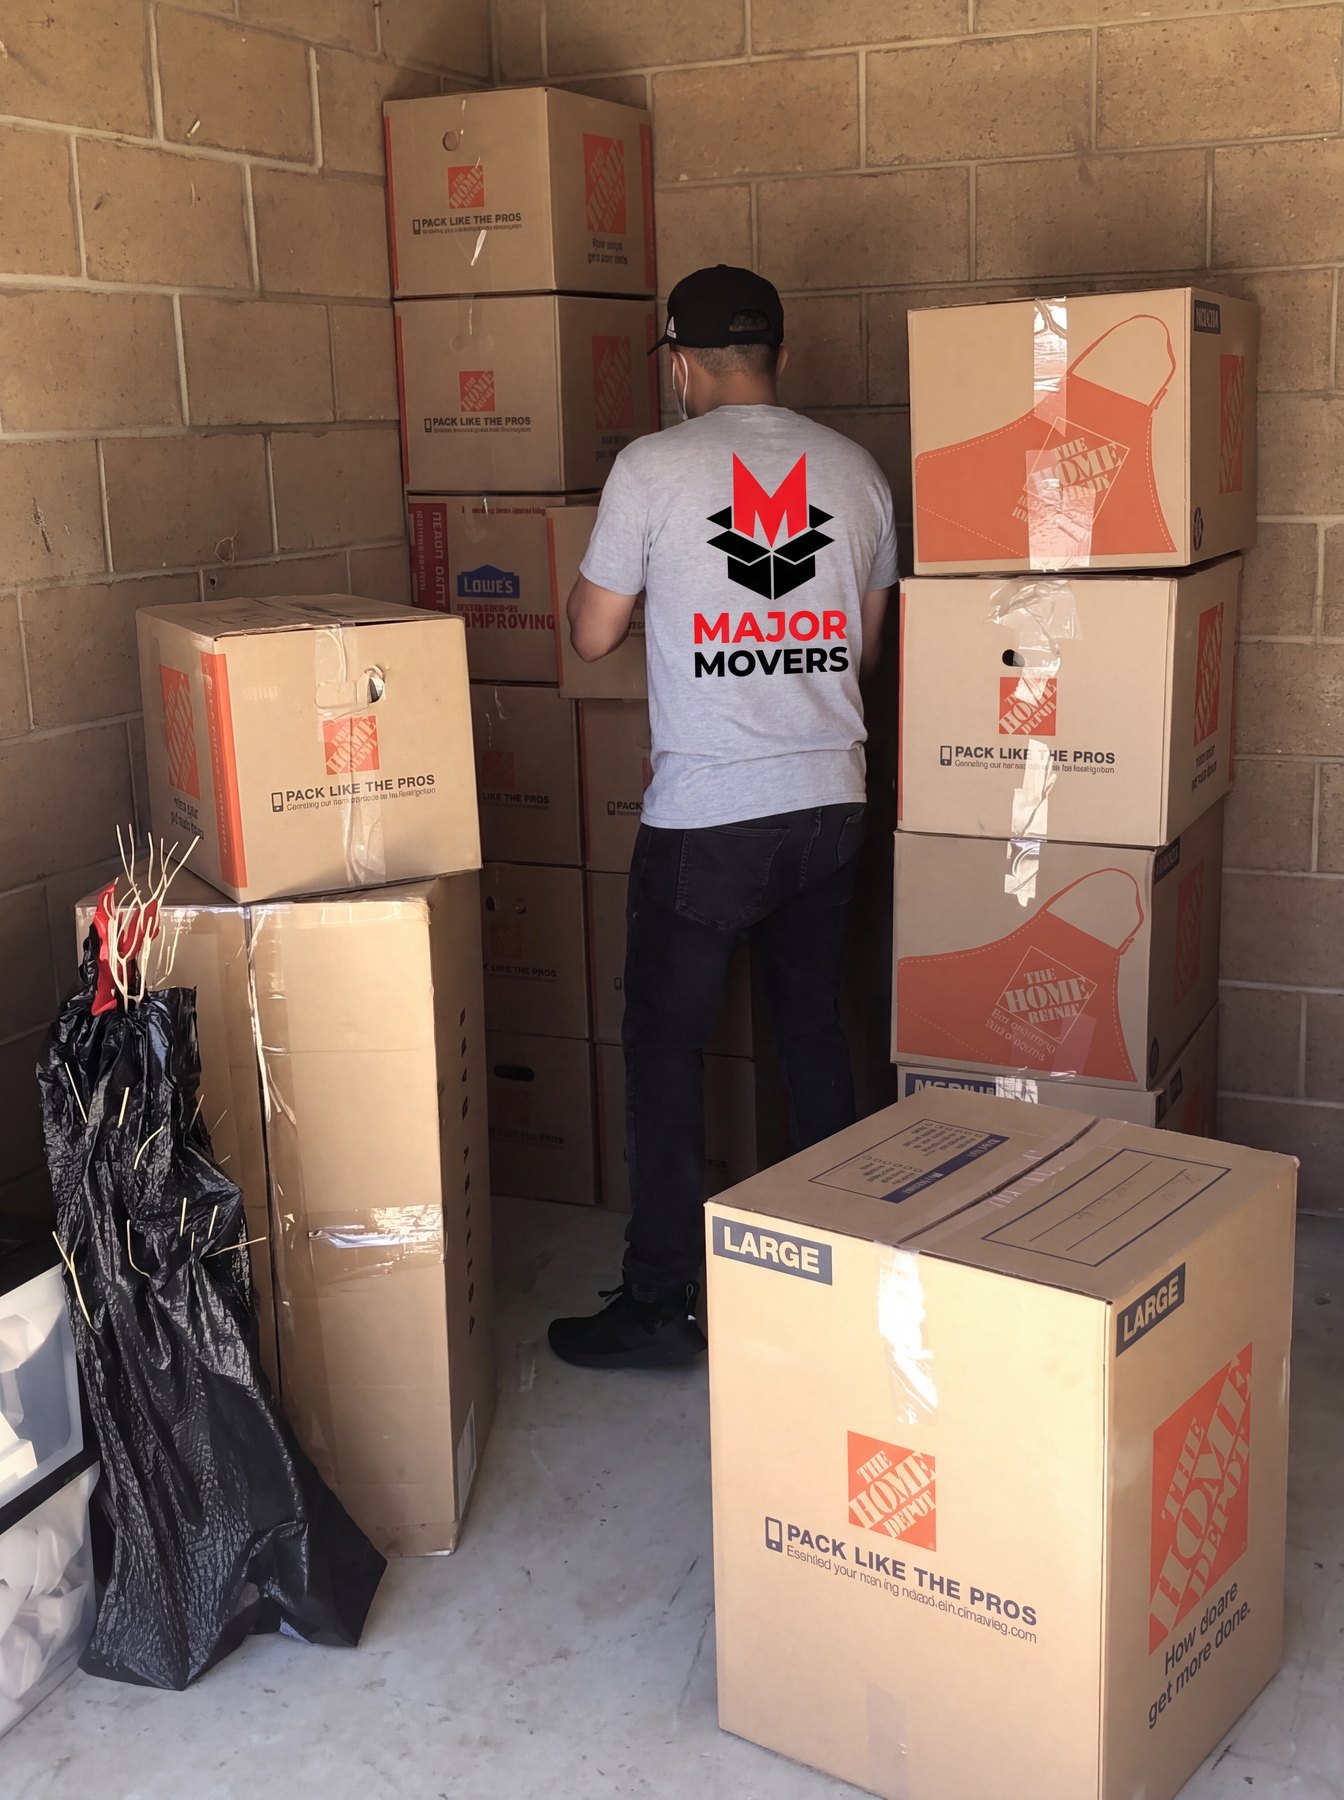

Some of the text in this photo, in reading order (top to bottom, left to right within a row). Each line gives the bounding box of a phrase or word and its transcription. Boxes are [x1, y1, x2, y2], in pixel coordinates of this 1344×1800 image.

[422, 212, 522, 228] PACK LIKE THE PROS
[433, 416, 531, 427] PACK LIKE THE PROS
[693, 610, 848, 645] MAJOR
[694, 646, 849, 678] MOVERS
[955, 746, 1116, 765] PACK LIKE THE PROS
[286, 787, 325, 802] PACK
[329, 783, 361, 797] LIKE
[365, 779, 393, 793] THE
[398, 774, 435, 789] PROS
[504, 793, 522, 803] THE
[524, 795, 549, 804] PROS
[617, 801, 643, 811] PACK
[1024, 968, 1056, 985] THE
[1004, 976, 1091, 1013] HOME
[724, 1226, 820, 1274] LARGE
[1124, 1275, 1179, 1342] LARGE
[856, 1450, 893, 1484] THE
[848, 1451, 936, 1530] HOME
[882, 1490, 936, 1538] DEPOT
[787, 1524, 1037, 1626] PACK LIKE THE PROS
[834, 1563, 857, 1579] your
[1148, 1601, 1251, 1730] get more done.
[1165, 1626, 1197, 1676] How
